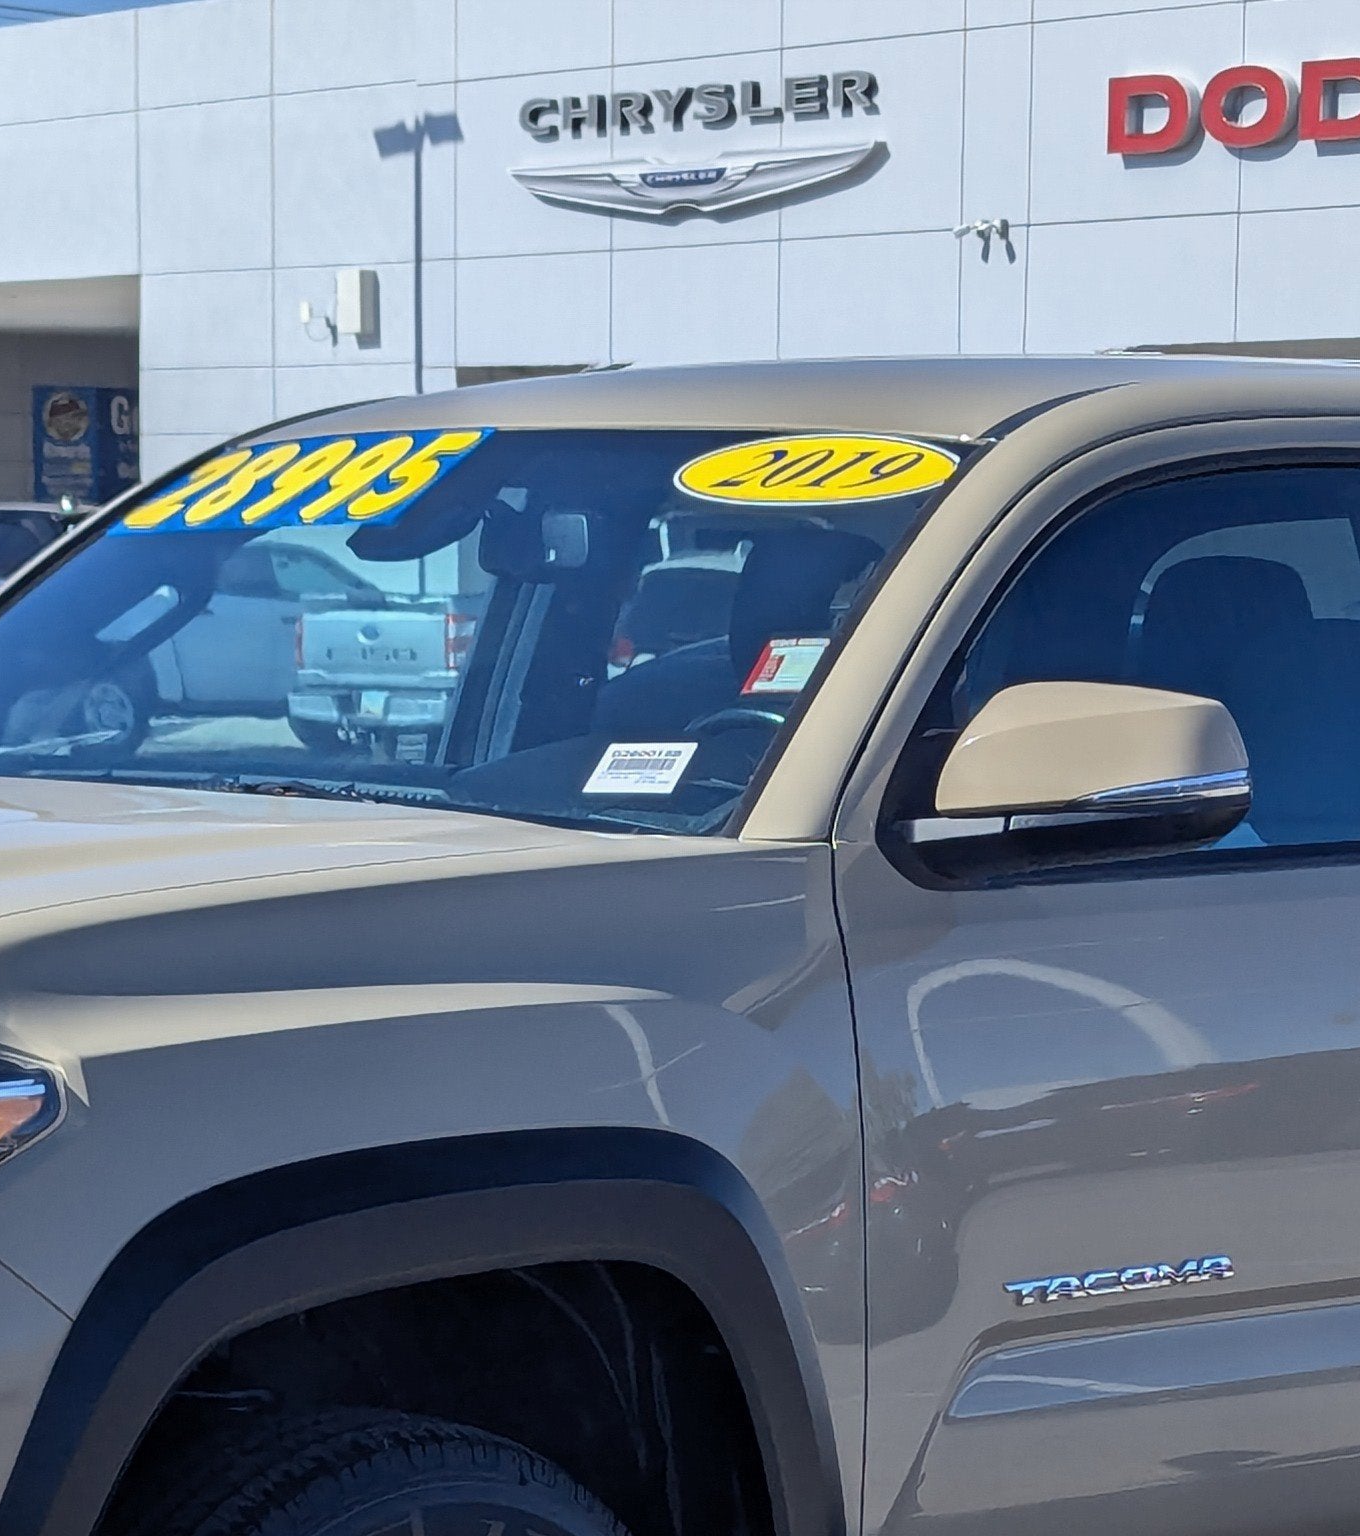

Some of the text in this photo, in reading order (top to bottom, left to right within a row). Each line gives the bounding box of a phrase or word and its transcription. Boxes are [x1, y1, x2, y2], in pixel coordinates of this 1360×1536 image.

[519, 70, 877, 142] CHRYSLER
[123, 431, 482, 530] 28995
[707, 449, 925, 488] 2019
[1003, 1254, 1235, 1306] TACOMA
